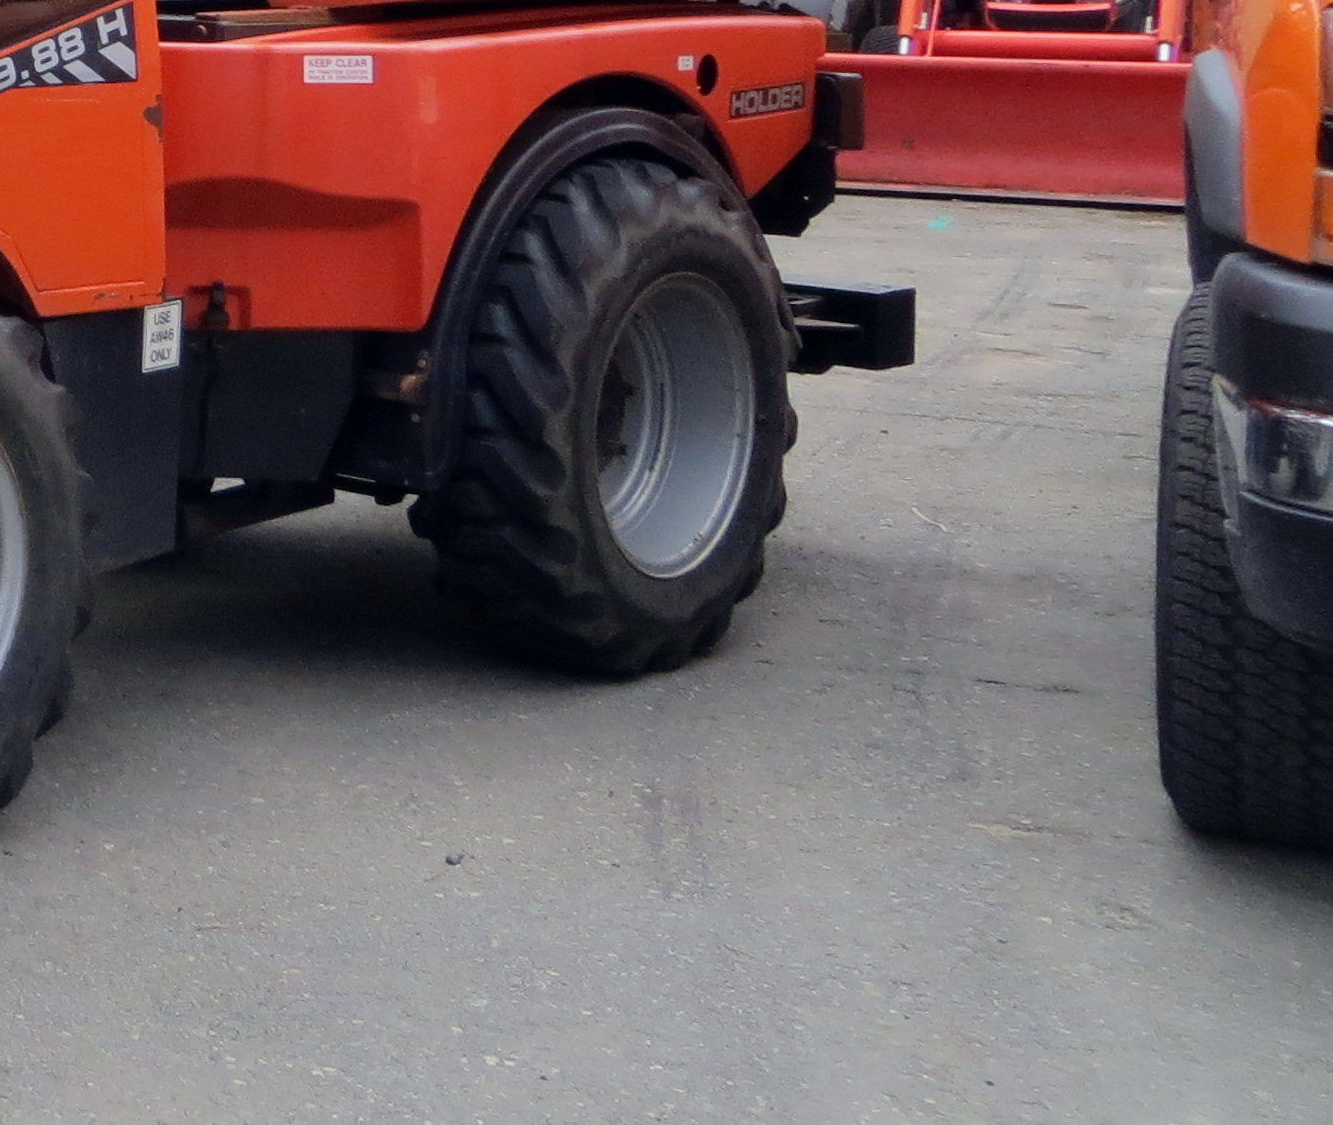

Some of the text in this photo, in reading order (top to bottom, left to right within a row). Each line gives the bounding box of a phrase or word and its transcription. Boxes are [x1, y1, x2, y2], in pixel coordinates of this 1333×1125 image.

[97, 8, 128, 45] H
[308, 58, 367, 67] KEEP CLEAR
[733, 85, 802, 115] HOLDER
[154, 311, 171, 325] USE
[150, 348, 172, 362] ONLY
